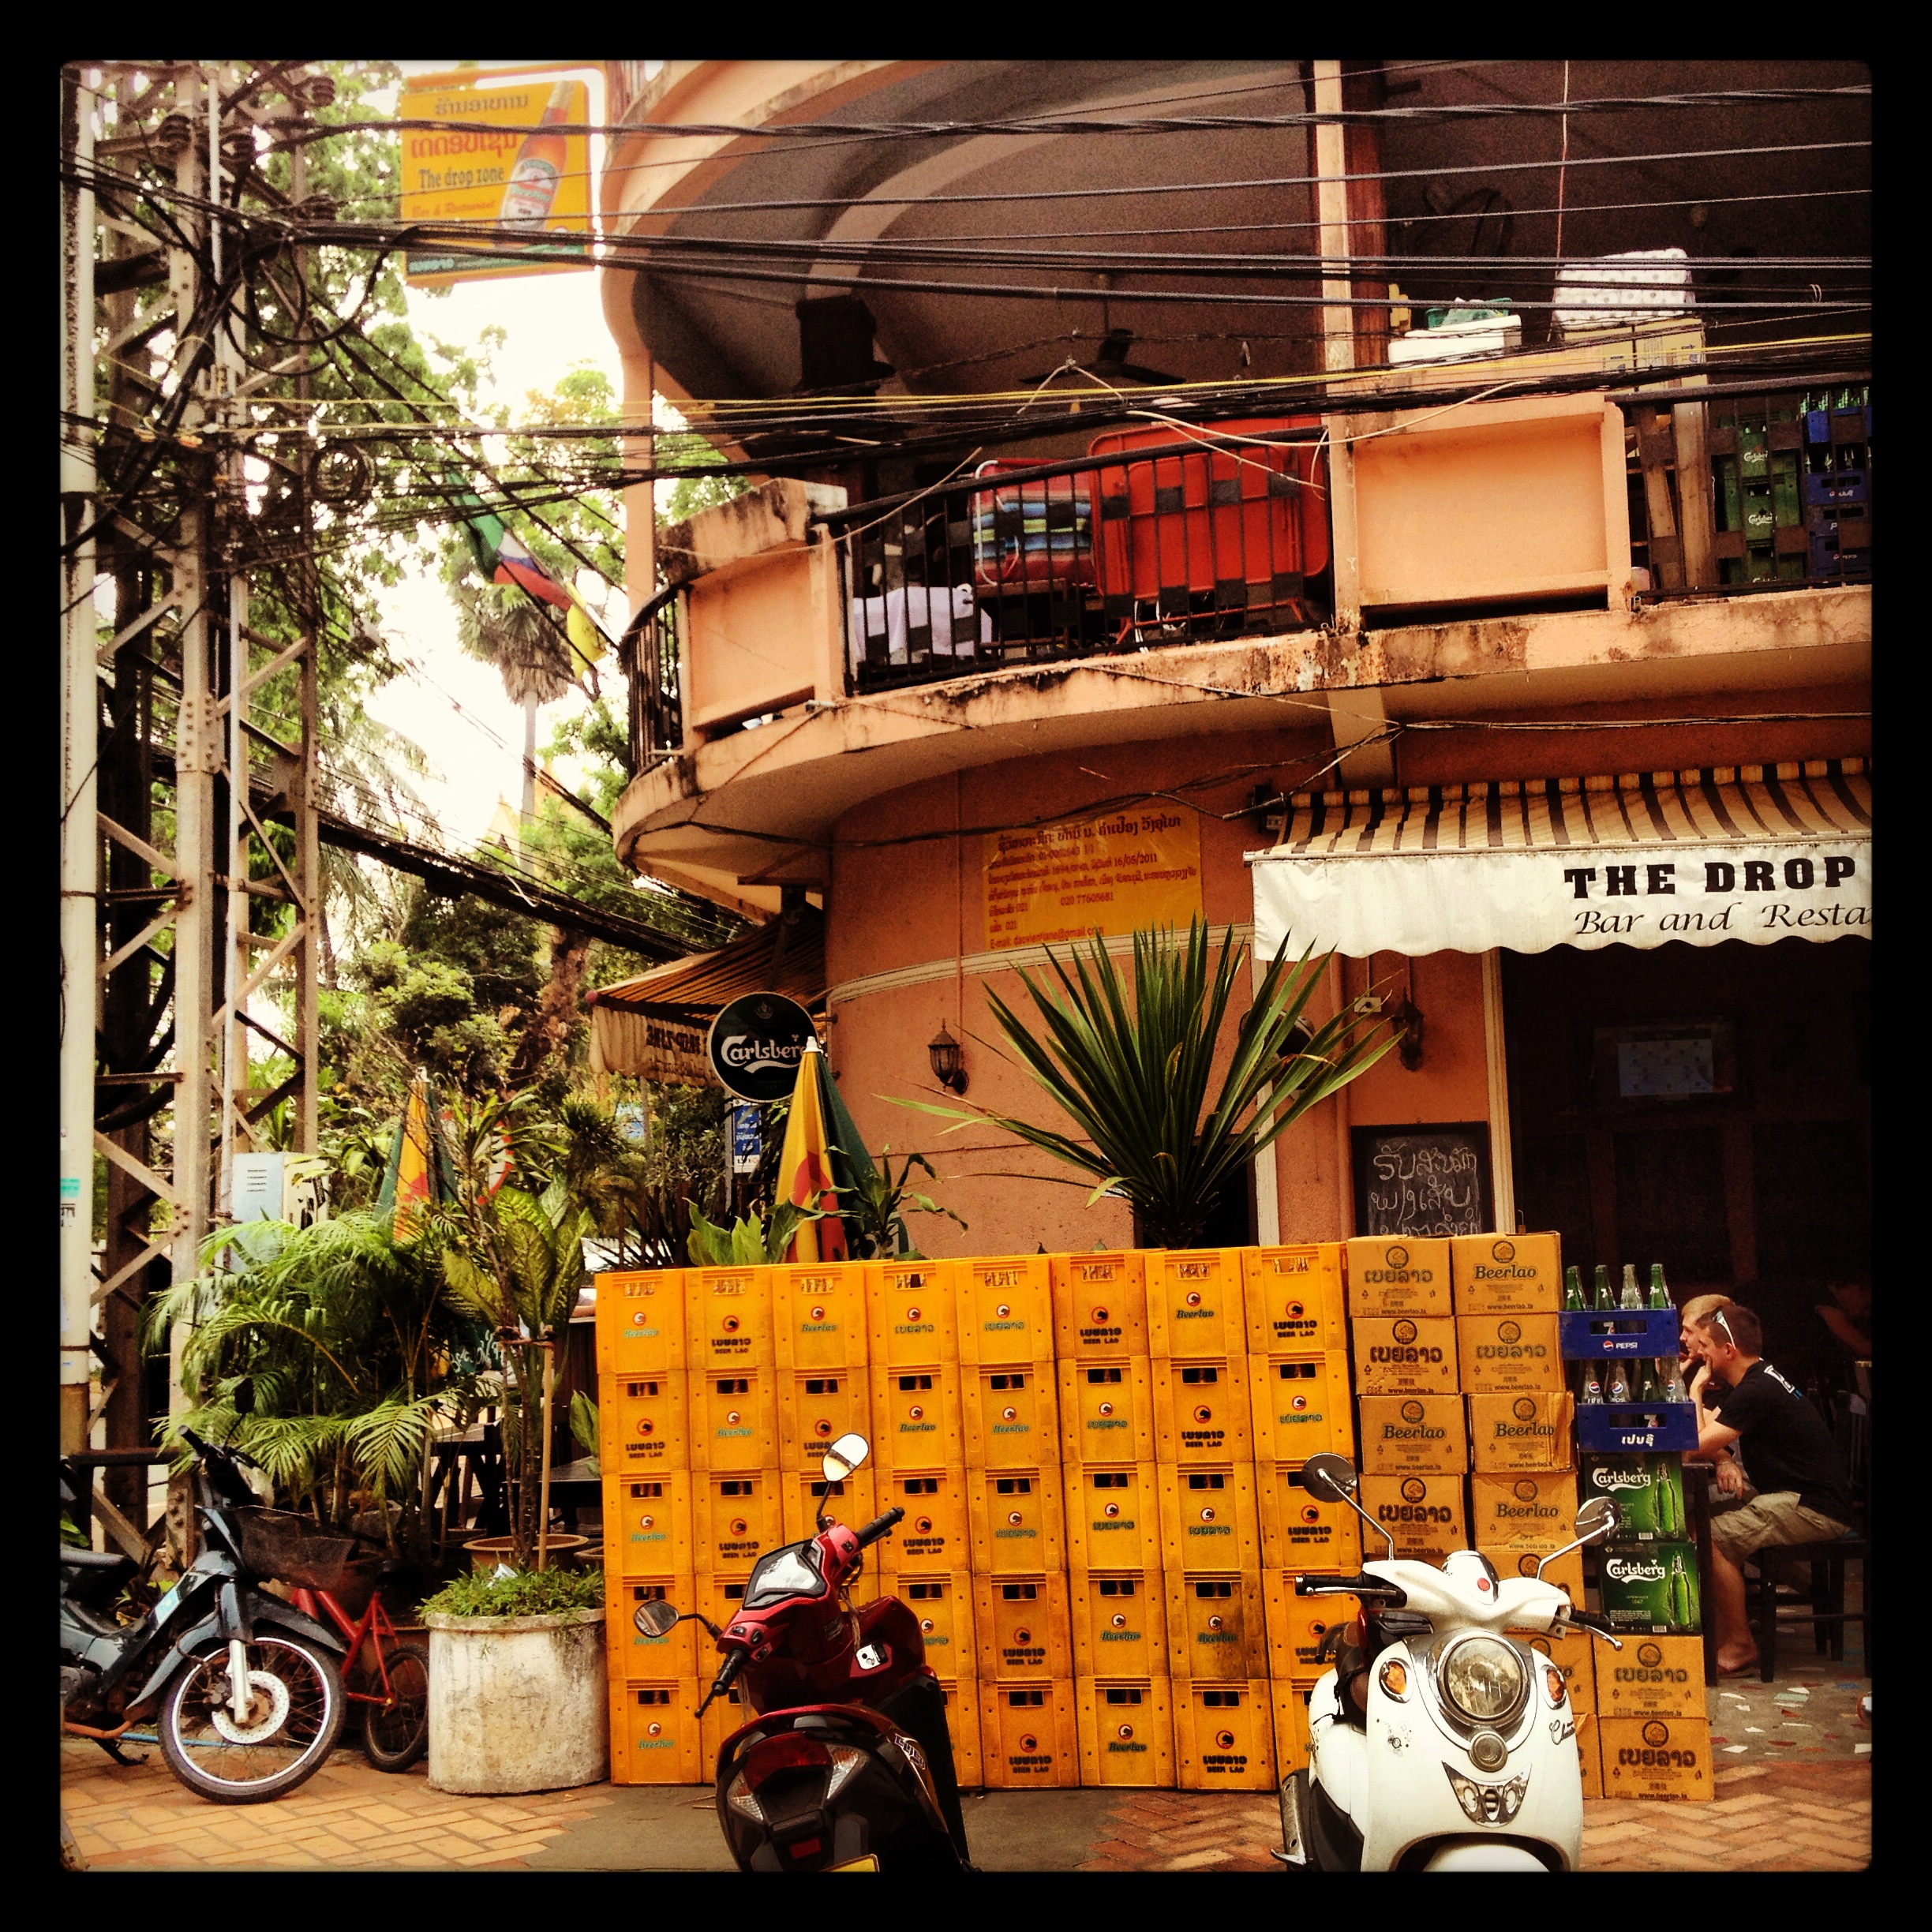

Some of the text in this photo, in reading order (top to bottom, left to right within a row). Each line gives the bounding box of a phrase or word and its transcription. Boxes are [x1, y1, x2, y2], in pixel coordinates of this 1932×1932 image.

[418, 166, 504, 189] The drop zone
[1563, 856, 1855, 899] THE DROP
[1574, 901, 1872, 935] Bar and Resta
[1364, 1268, 1433, 1284] ເບຍລາວ
[1473, 1264, 1537, 1280] Beerlao
[1176, 1308, 1215, 1320] Beerlao
[1370, 1344, 1443, 1364] ເບຍລາວ
[1476, 1343, 1548, 1360] ເບຍລາວ
[900, 1422, 936, 1432] Beerlao
[1382, 1424, 1447, 1440] Beerlao
[1495, 1422, 1556, 1437] Beerlao
[1592, 1466, 1651, 1492] Carlsberg
[1378, 1504, 1452, 1523] ເບຍລາວ
[1496, 1503, 1559, 1519] Beerlao
[1606, 1559, 1666, 1584] Carlsberg
[1613, 1667, 1689, 1683] ເບຍລາວ
[1618, 1747, 1698, 1768] ເບຍລາວ
